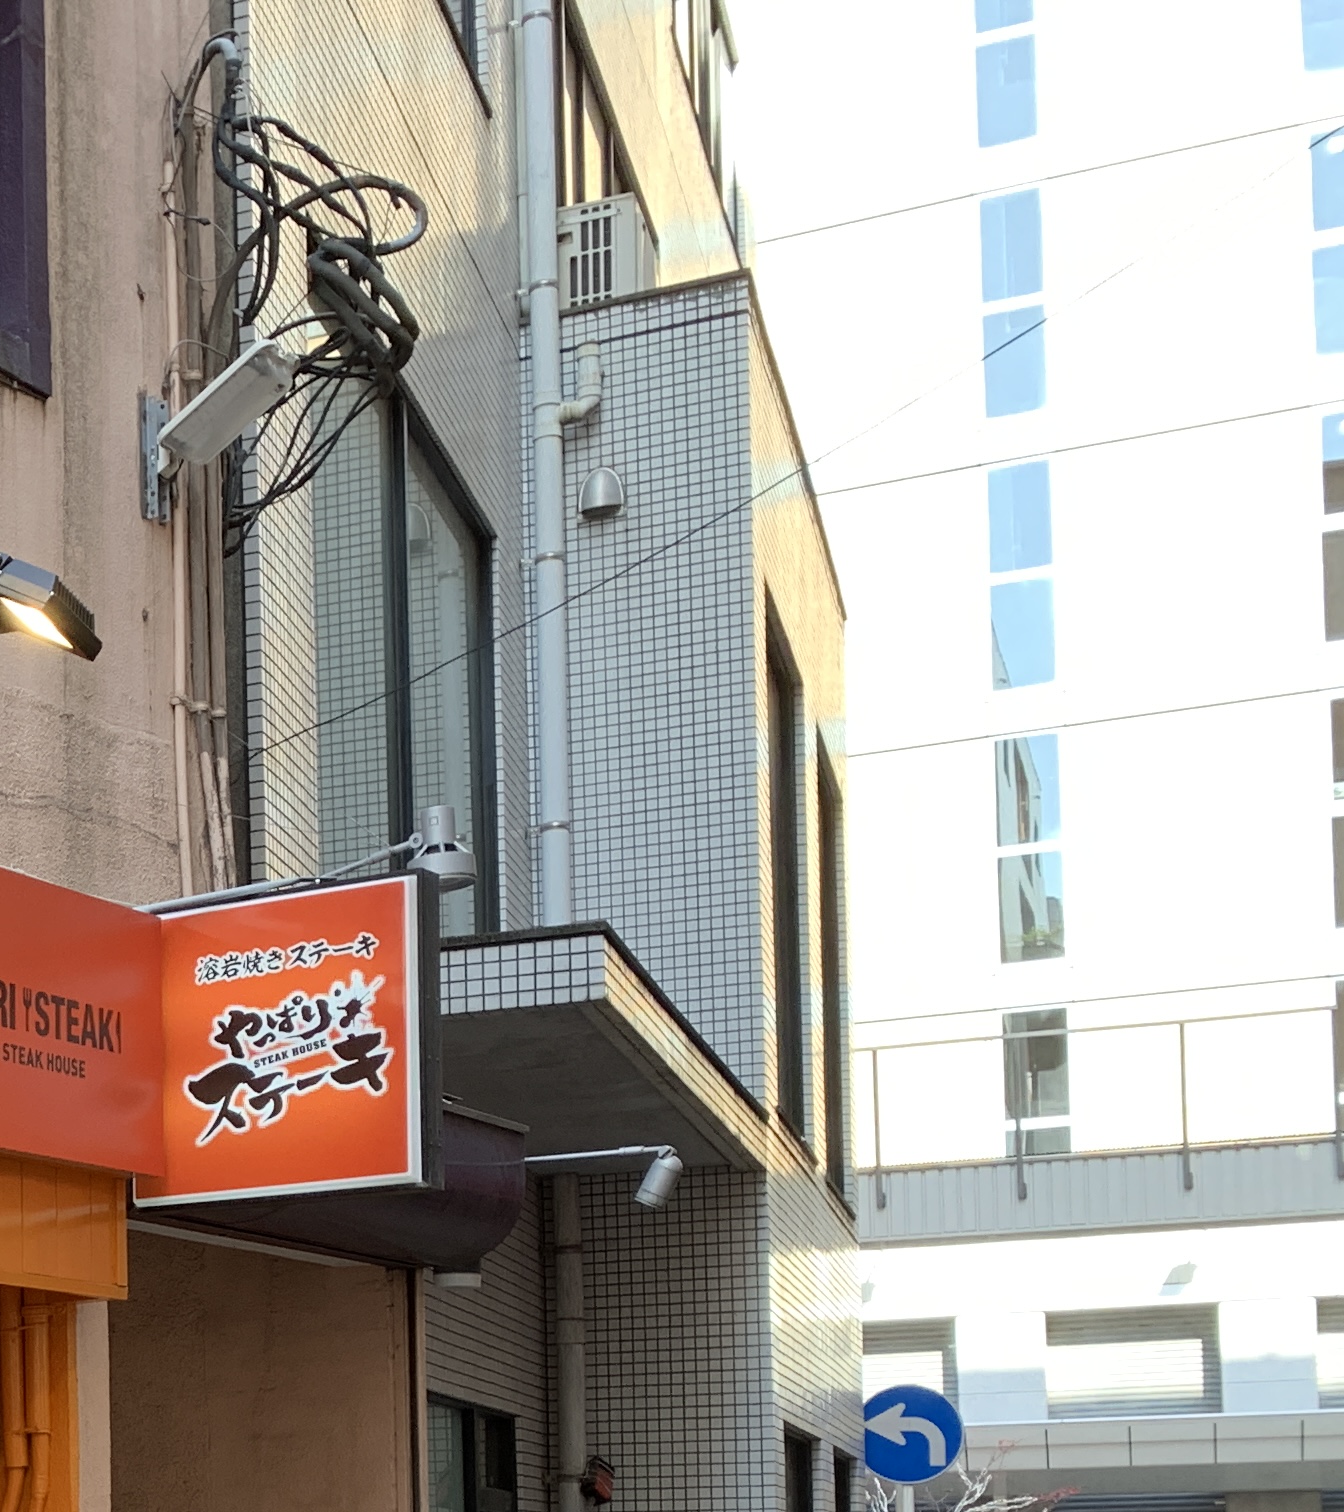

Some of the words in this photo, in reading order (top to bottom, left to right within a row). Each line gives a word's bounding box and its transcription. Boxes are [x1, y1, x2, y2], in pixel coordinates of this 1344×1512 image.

[196, 935, 378, 982] 溶岩焼きステーキ
[34, 991, 115, 1053] STEAK
[213, 995, 332, 1059] やっぱり
[2, 1043, 44, 1070] STEAK
[46, 1053, 86, 1079] HOUSE
[253, 1049, 289, 1069] STEAK
[292, 1039, 327, 1059] HOUSE
[188, 1031, 390, 1142] ステーキ
